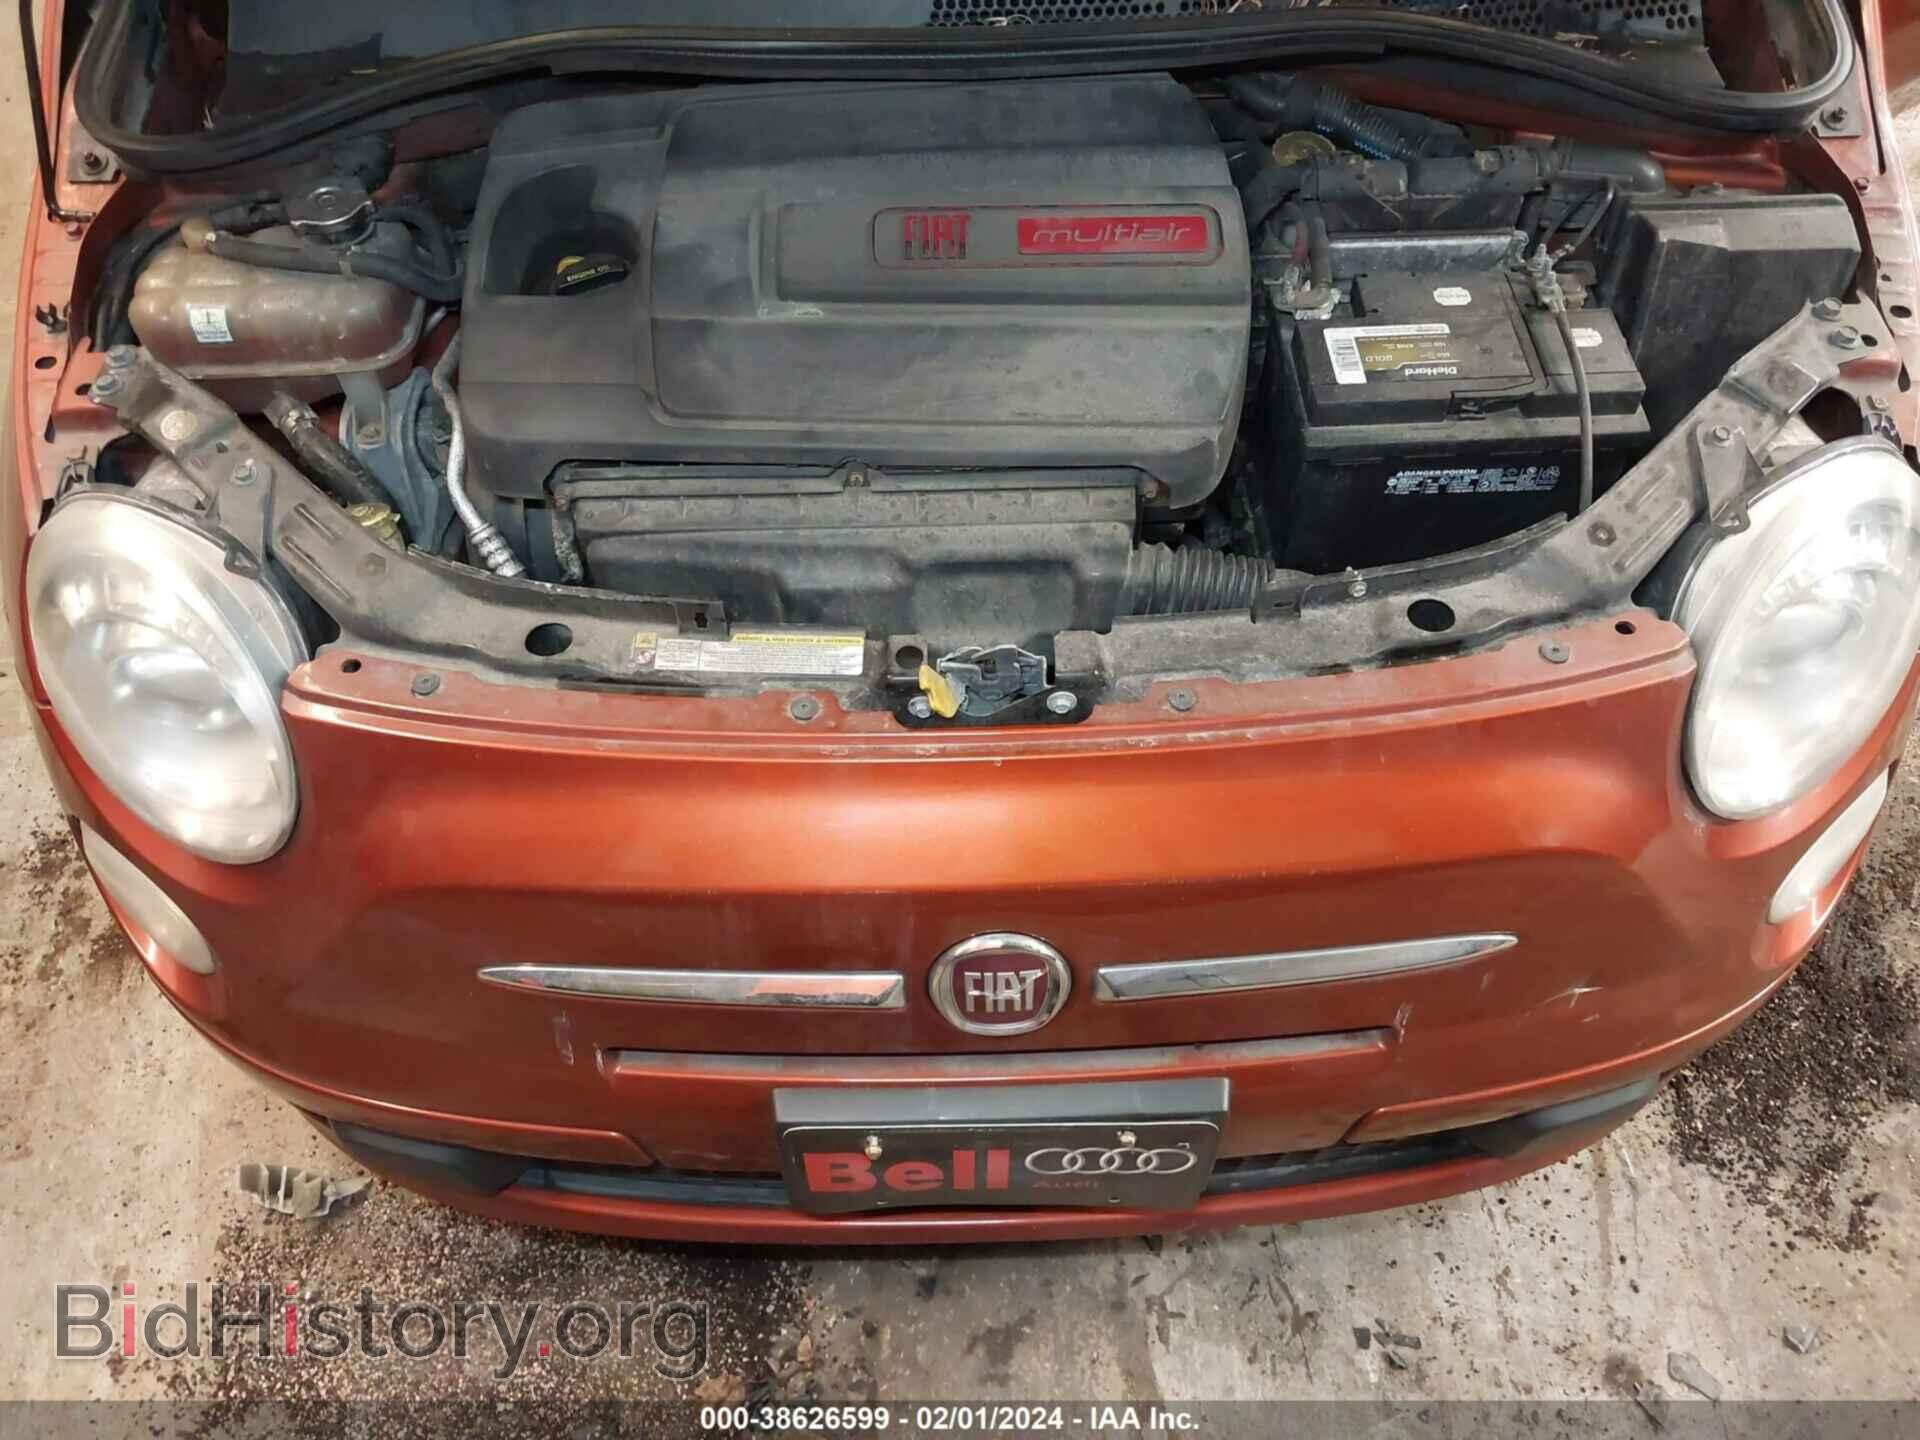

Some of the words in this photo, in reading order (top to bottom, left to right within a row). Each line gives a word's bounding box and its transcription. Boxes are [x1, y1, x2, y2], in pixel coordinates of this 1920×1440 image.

[903, 213, 971, 260] FIAT
[1032, 221, 1191, 243] multiair
[1405, 366, 1457, 377] DieHard
[964, 968, 1046, 1013] FIAT
[803, 1149, 1010, 1193] Bell
